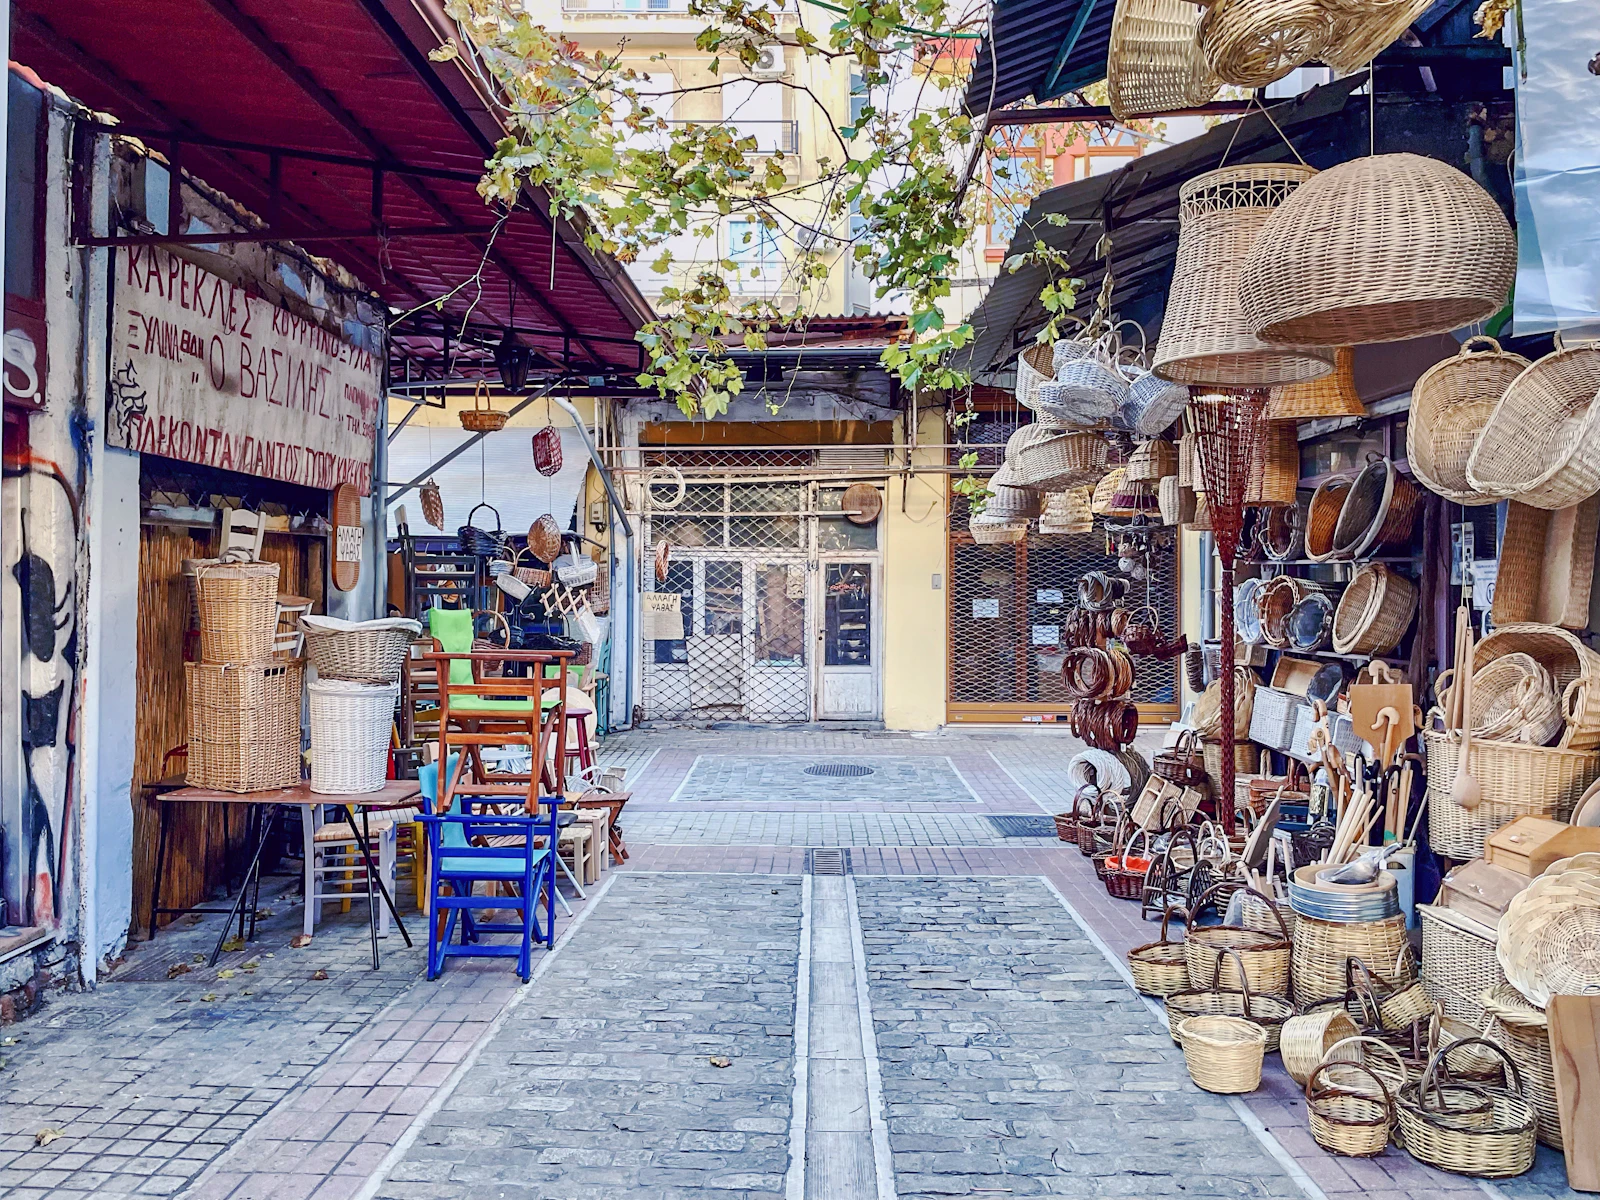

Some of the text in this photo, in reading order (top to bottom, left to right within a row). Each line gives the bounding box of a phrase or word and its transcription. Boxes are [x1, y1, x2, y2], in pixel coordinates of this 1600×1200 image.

[127, 245, 258, 339] ΚΑΡΕΚΛΕΣ
[337, 527, 363, 544] ΑΛΛΑΓΗ
[646, 594, 678, 604] ΑΛΛΑΓΗ
